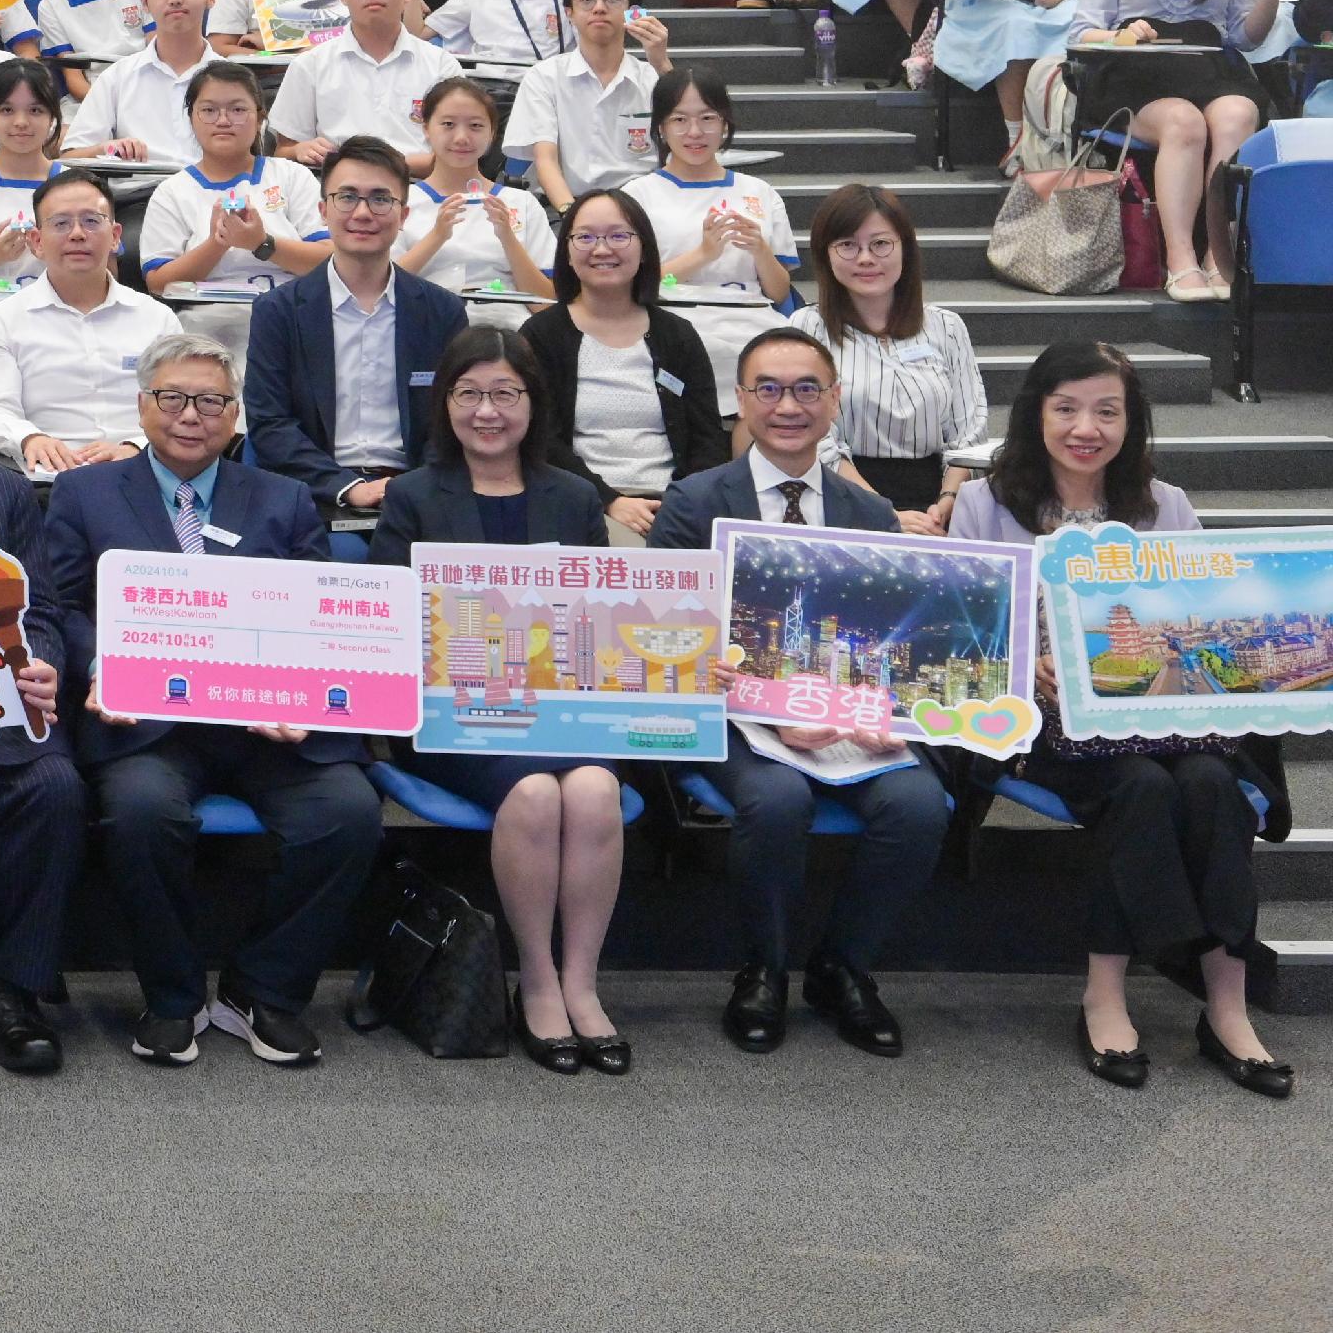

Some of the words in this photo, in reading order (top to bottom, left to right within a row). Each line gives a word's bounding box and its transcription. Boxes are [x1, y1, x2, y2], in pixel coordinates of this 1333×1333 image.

[124, 564, 189, 578] A20241014
[122, 586, 228, 609] 香港西九龍站
[252, 590, 289, 602] G1014
[318, 597, 390, 619] 廣州南站
[337, 642, 368, 654] Second
[370, 644, 391, 655] Class
[207, 685, 309, 707] 祝你旅途愉快
